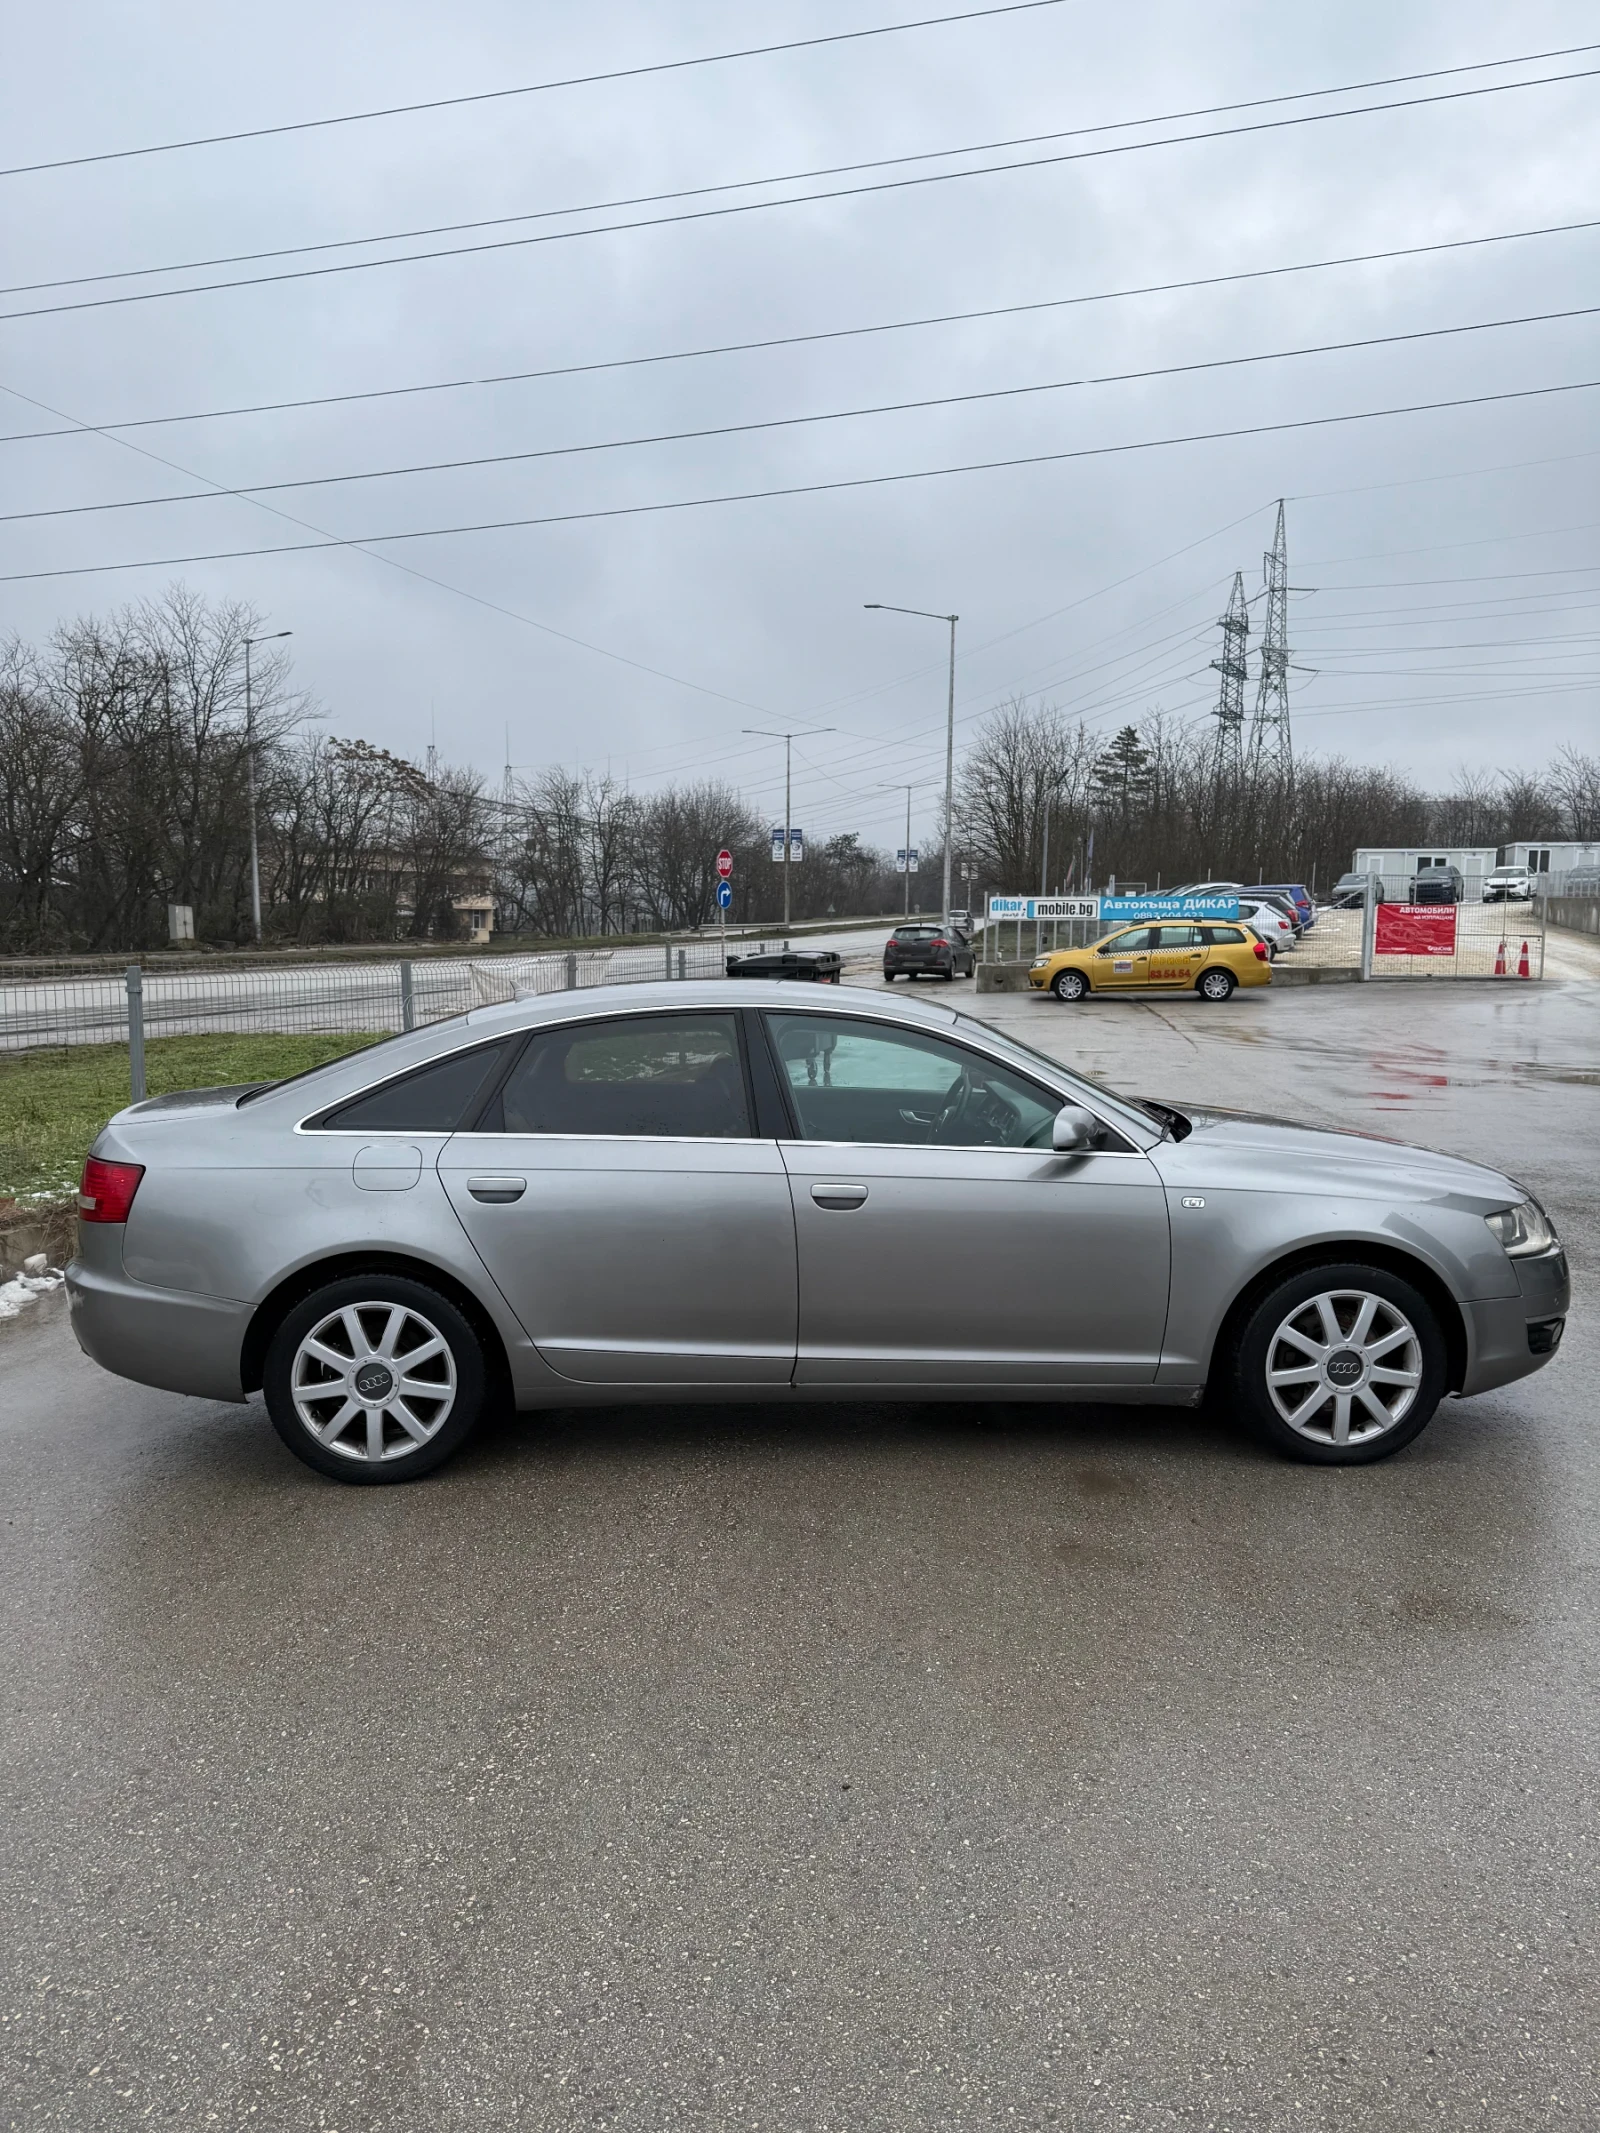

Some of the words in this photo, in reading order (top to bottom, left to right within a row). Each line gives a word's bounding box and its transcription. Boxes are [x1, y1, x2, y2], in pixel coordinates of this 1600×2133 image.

[718, 858, 731, 870] STOP
[1038, 902, 1093, 916] mobile.bg
[1104, 900, 1180, 910] Автокъща
[1183, 899, 1237, 910] ДИКАР
